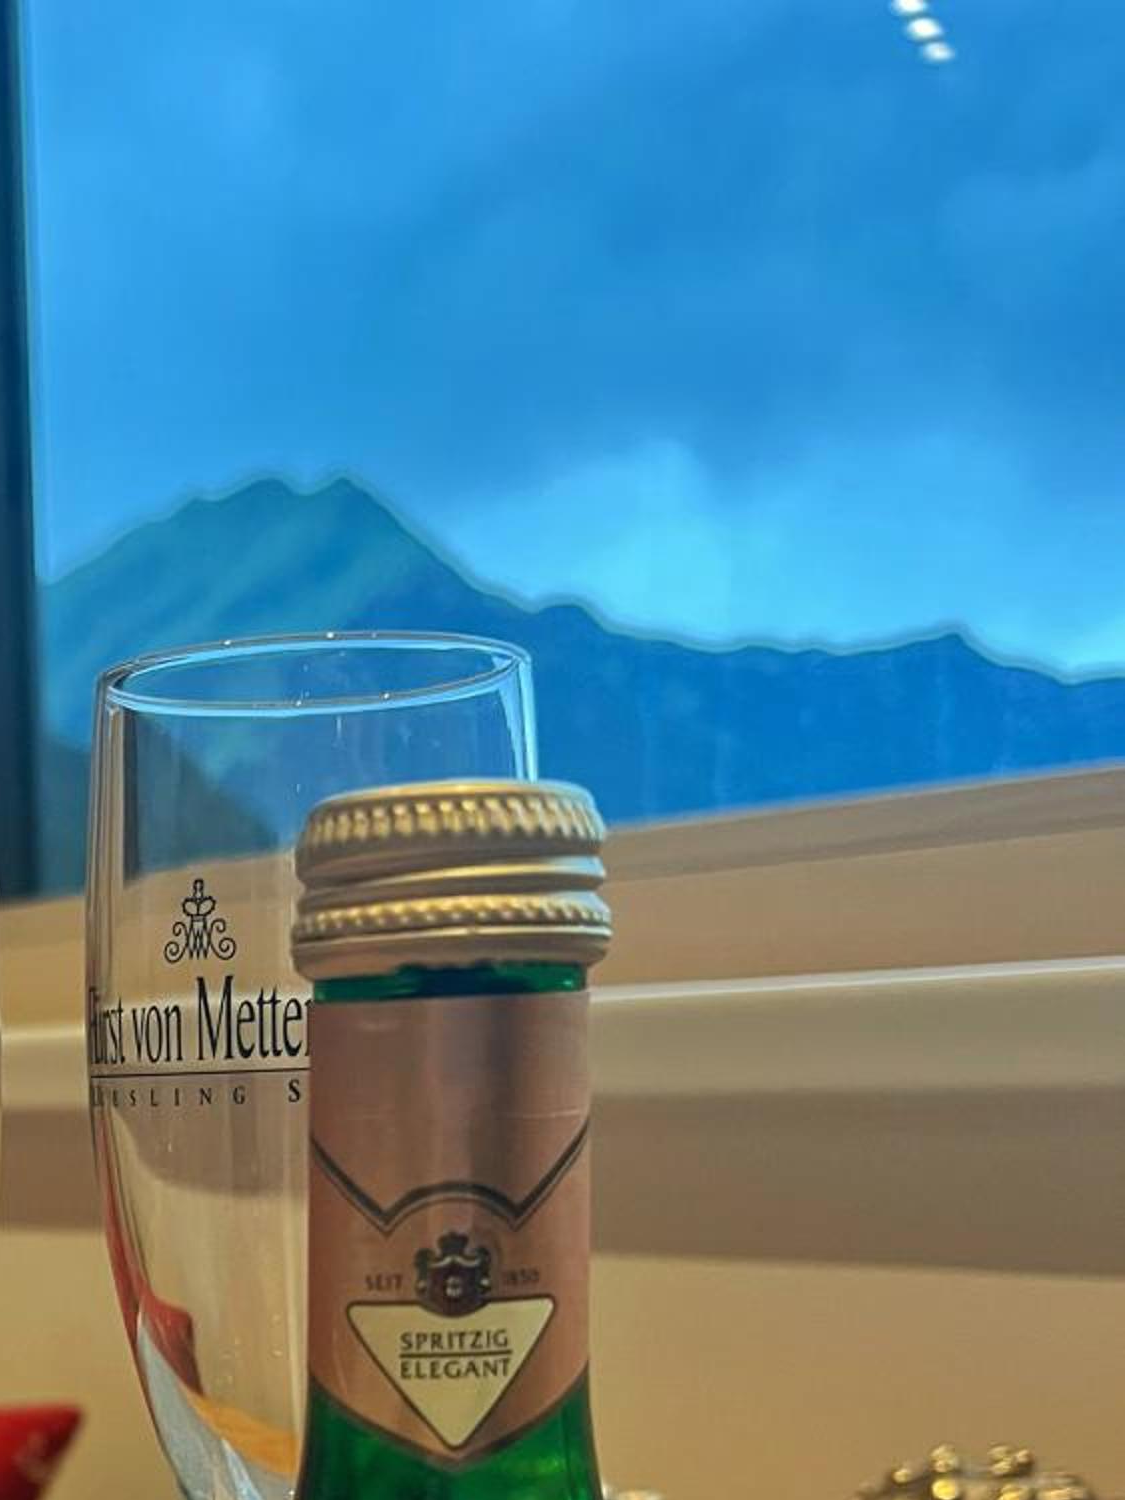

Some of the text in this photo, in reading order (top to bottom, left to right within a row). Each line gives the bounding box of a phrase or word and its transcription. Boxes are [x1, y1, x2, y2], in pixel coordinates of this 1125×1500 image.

[131, 1004, 183, 1063] von
[399, 1328, 510, 1351] SPRITZIG
[399, 1358, 512, 1380] ELEGANT
